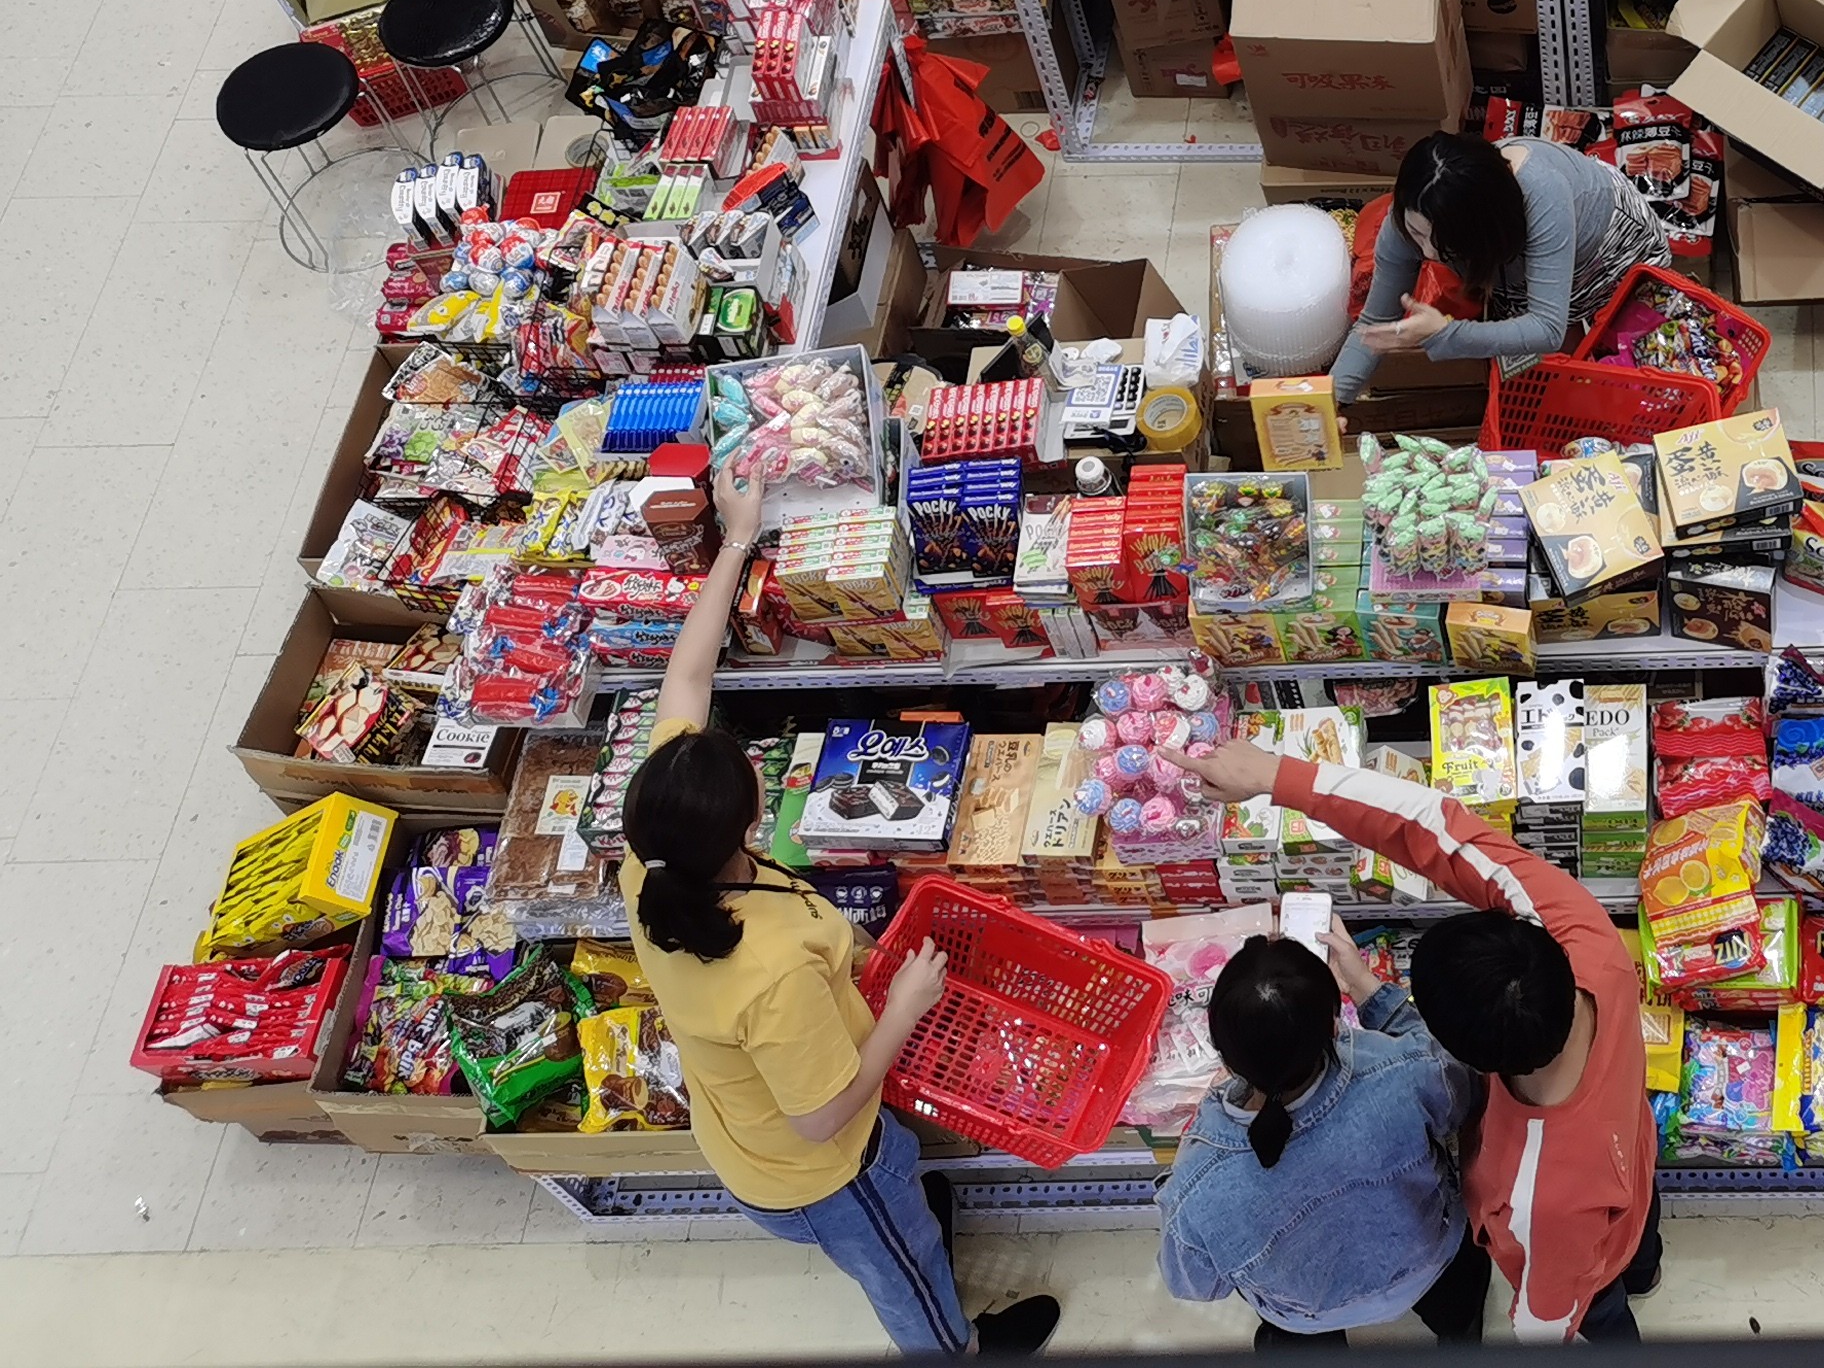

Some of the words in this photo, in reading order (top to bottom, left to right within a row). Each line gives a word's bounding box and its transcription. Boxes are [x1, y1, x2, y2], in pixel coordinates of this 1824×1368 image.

[1281, 71, 1396, 93] 可吸果冻
[913, 500, 956, 516] POCKY
[969, 505, 1012, 521] POCKY
[1586, 709, 1631, 725] EDO
[436, 728, 490, 743] Cookie
[847, 729, 931, 763] 오예스
[1442, 759, 1479, 775] Fruit
[1713, 932, 1751, 964] RITZ
